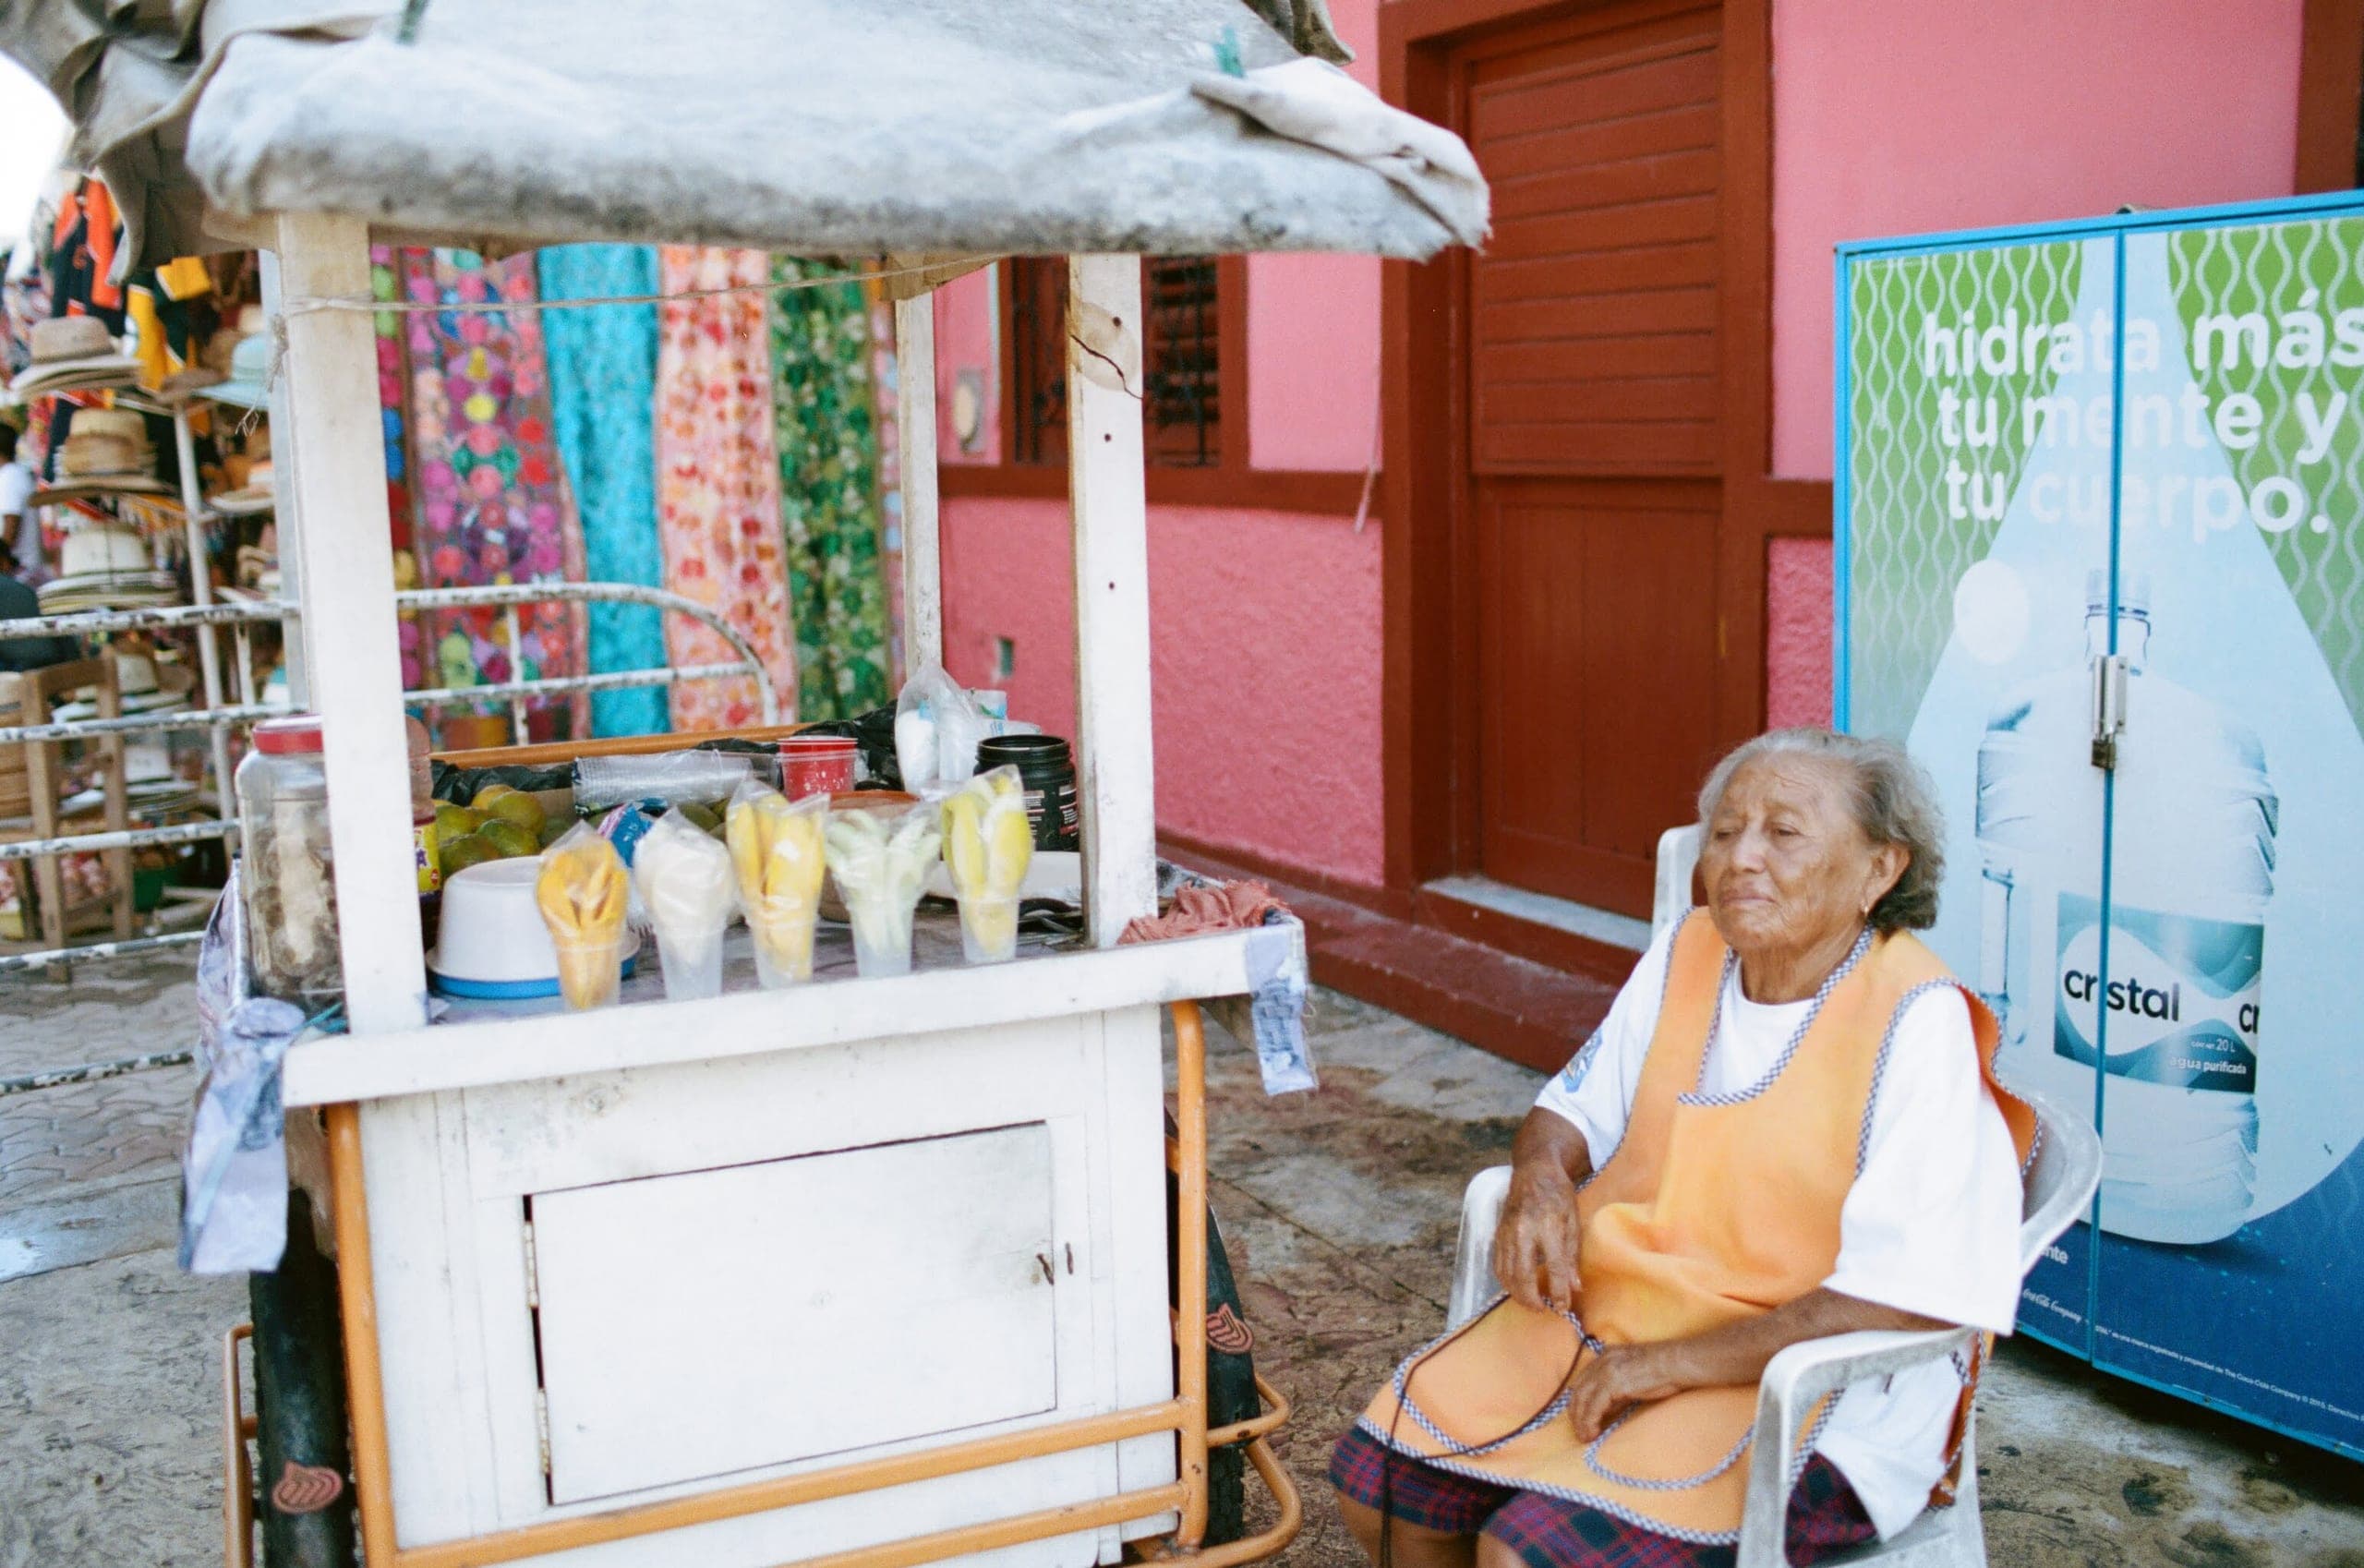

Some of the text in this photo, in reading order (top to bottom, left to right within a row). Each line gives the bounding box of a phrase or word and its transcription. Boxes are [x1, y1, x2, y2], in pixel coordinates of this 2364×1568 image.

[1924, 287, 2364, 378] hidrata más
[1939, 381, 2347, 465] tu mente y
[1945, 459, 2330, 545] tu cuerpo.
[2065, 970, 2180, 1021] crstal
[2170, 1056, 2247, 1074] agua purificada
[2216, 1038, 2228, 1052] 20
[2230, 1041, 2236, 1053] L
[2225, 1369, 2236, 1378] The
[2270, 1384, 2301, 1403] Company
